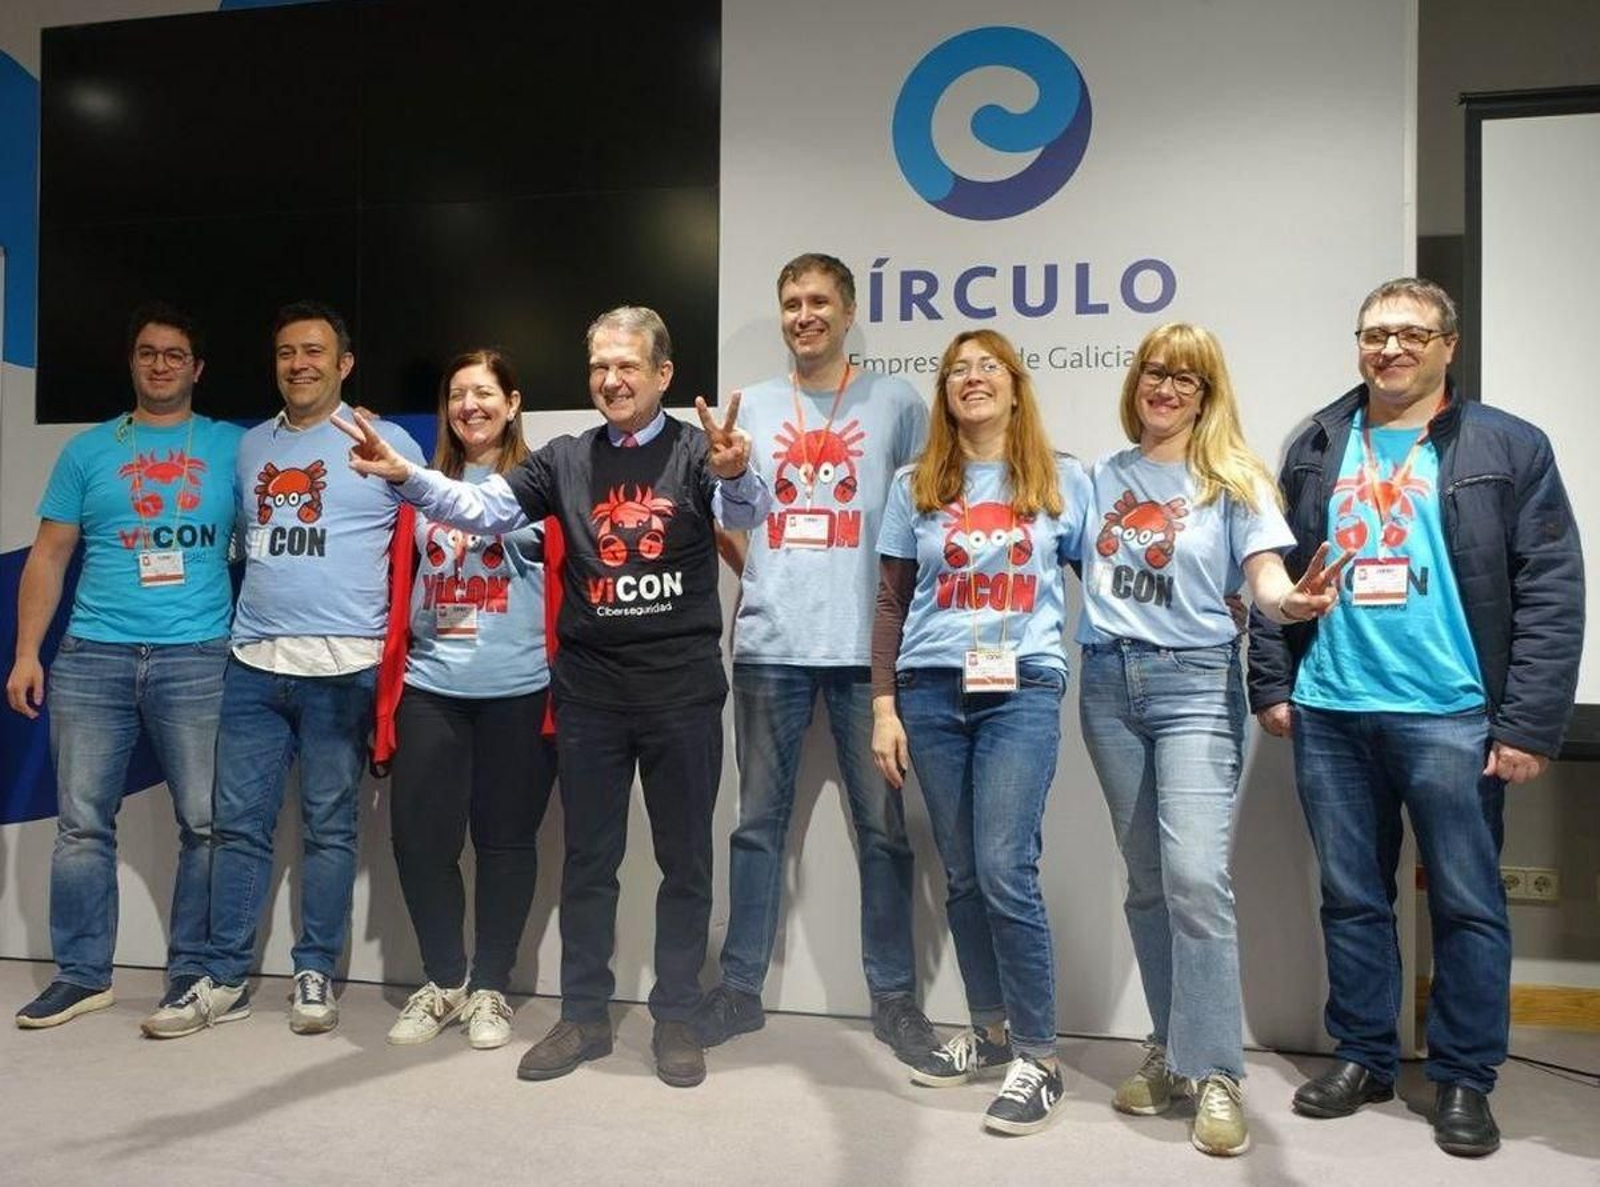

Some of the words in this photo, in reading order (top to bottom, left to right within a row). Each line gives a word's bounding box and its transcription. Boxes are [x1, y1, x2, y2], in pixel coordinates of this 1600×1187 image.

[869, 257, 1178, 323] ÍRCULO
[848, 352, 940, 376] Empres
[1048, 345, 1136, 369] Galicia
[589, 572, 683, 604] ViCON
[597, 601, 673, 617] Ciberseguridad
